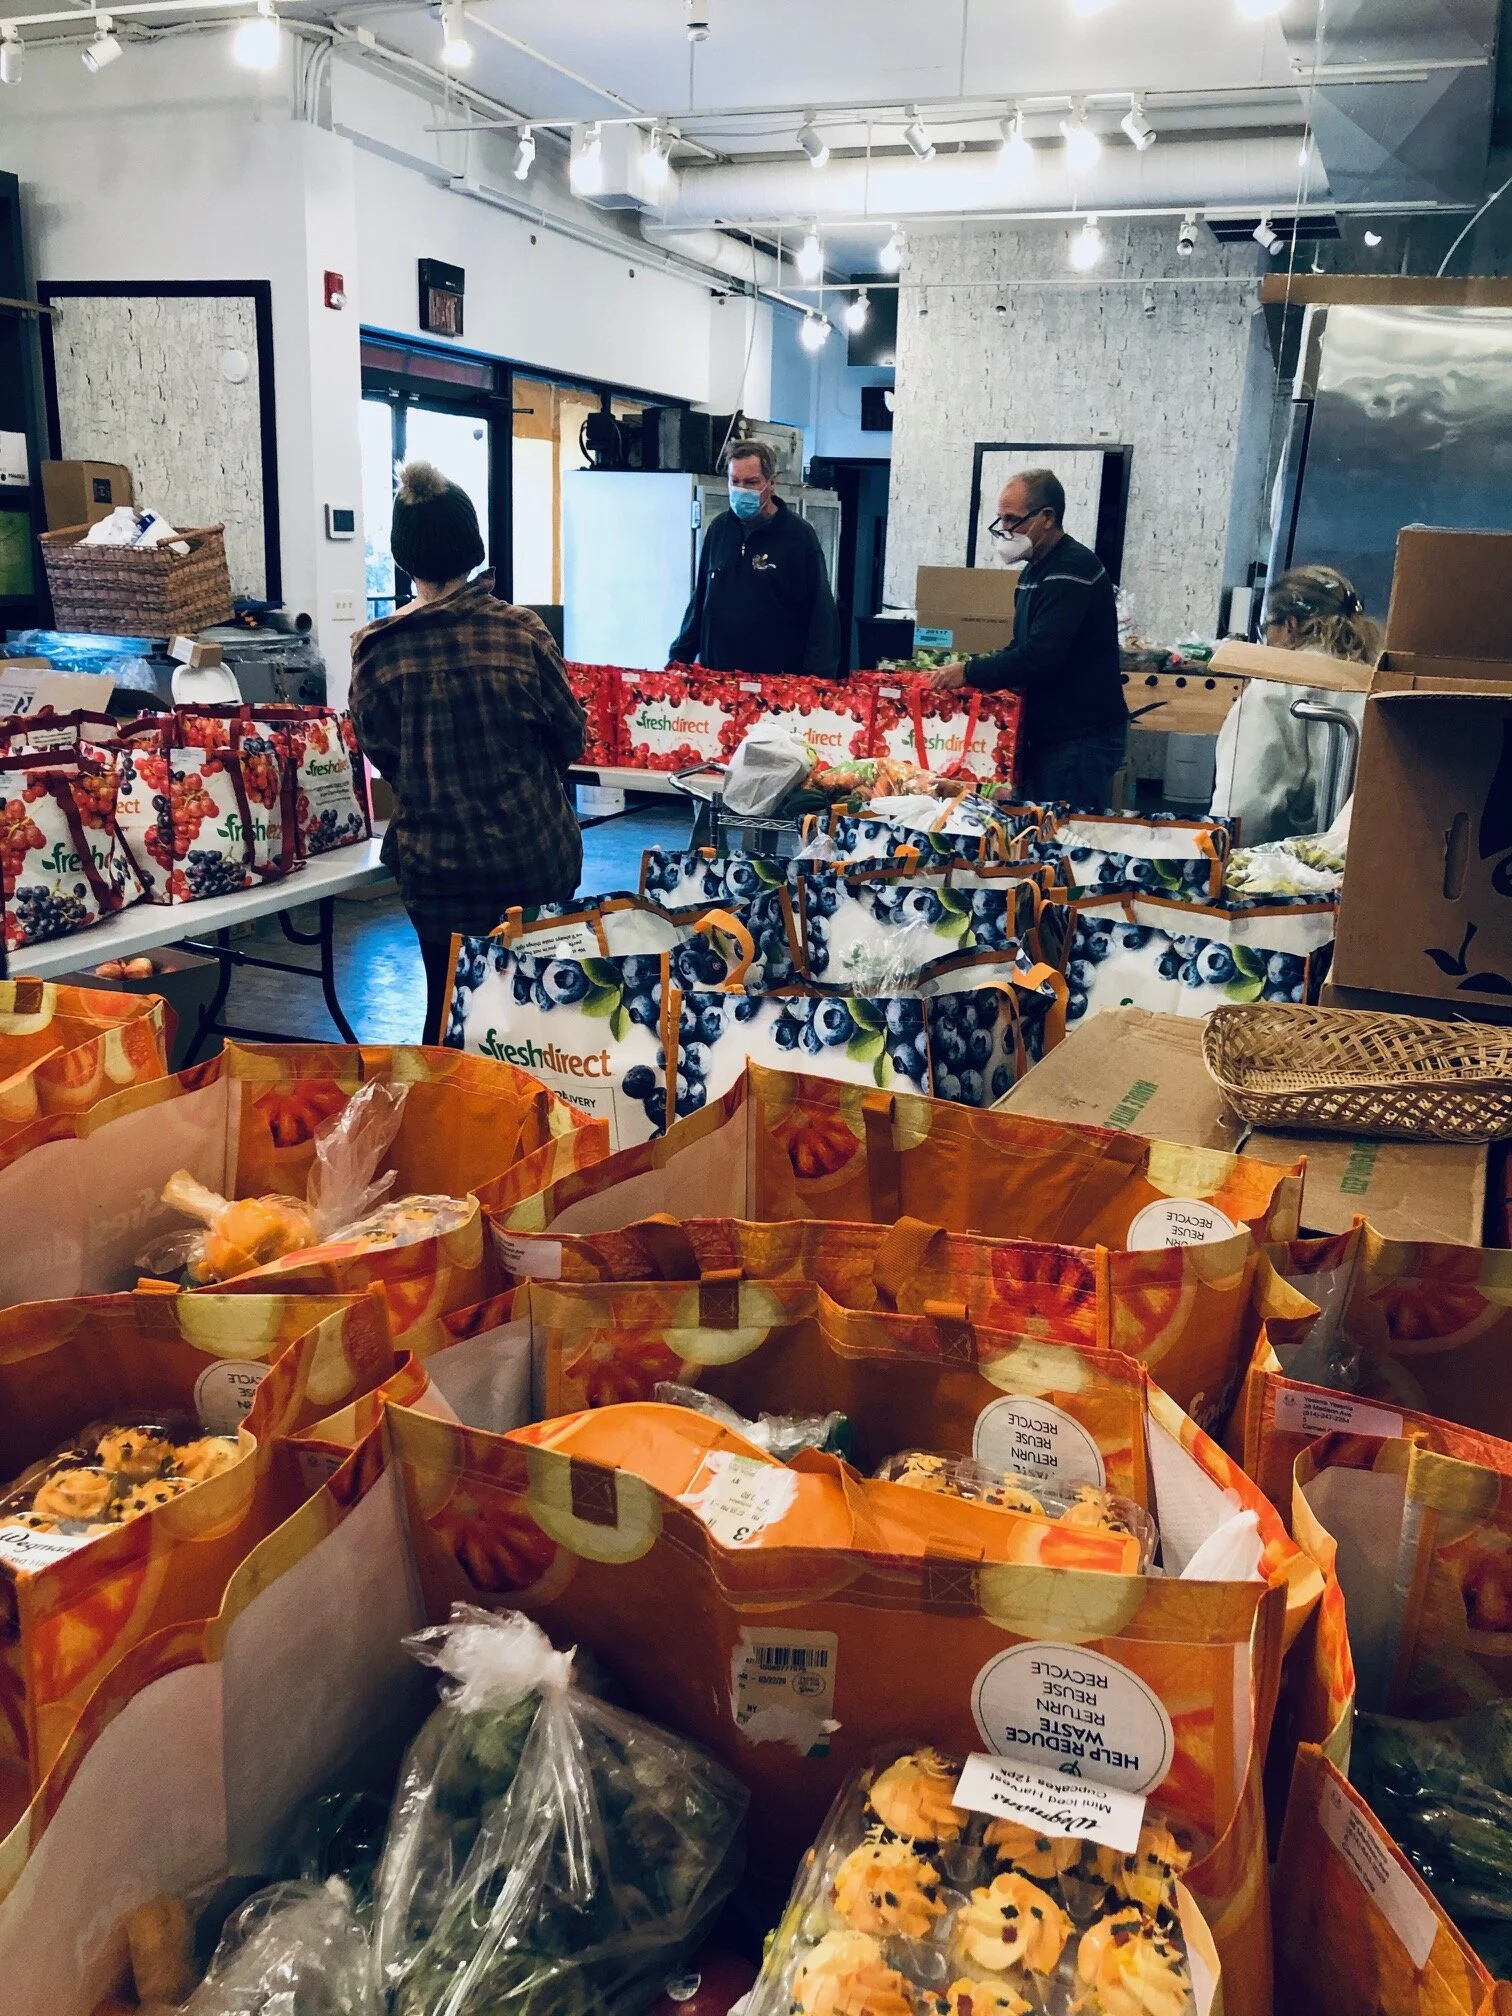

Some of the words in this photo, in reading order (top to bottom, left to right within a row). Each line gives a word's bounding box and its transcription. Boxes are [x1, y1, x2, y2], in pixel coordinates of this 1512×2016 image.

[637, 711, 710, 734] freshdirect
[483, 1028, 612, 1077] freshdirect
[1166, 1211, 1213, 1229] RECYCLE
[1171, 1225, 1205, 1240] REUSE
[1008, 1412, 1058, 1435] RECYCLE
[1015, 1431, 1052, 1449] REUSE
[1011, 1447, 1058, 1467] RETURN
[1031, 1661, 1108, 1689] RECYCLE
[1042, 1681, 1097, 1706] REUSE
[1036, 1698, 1106, 1727] RETURN
[1005, 1726, 1085, 1758] REDUCE
[1039, 1717, 1104, 1746] WASTE
[1089, 1750, 1140, 1771] HELP
[990, 1772, 1044, 1799] Harvest
[1000, 1767, 1031, 1784] 12pk
[1037, 1778, 1108, 1800] Cupcakes
[1048, 1794, 1078, 1808] Iced
[1082, 1798, 1112, 1815] Mini
